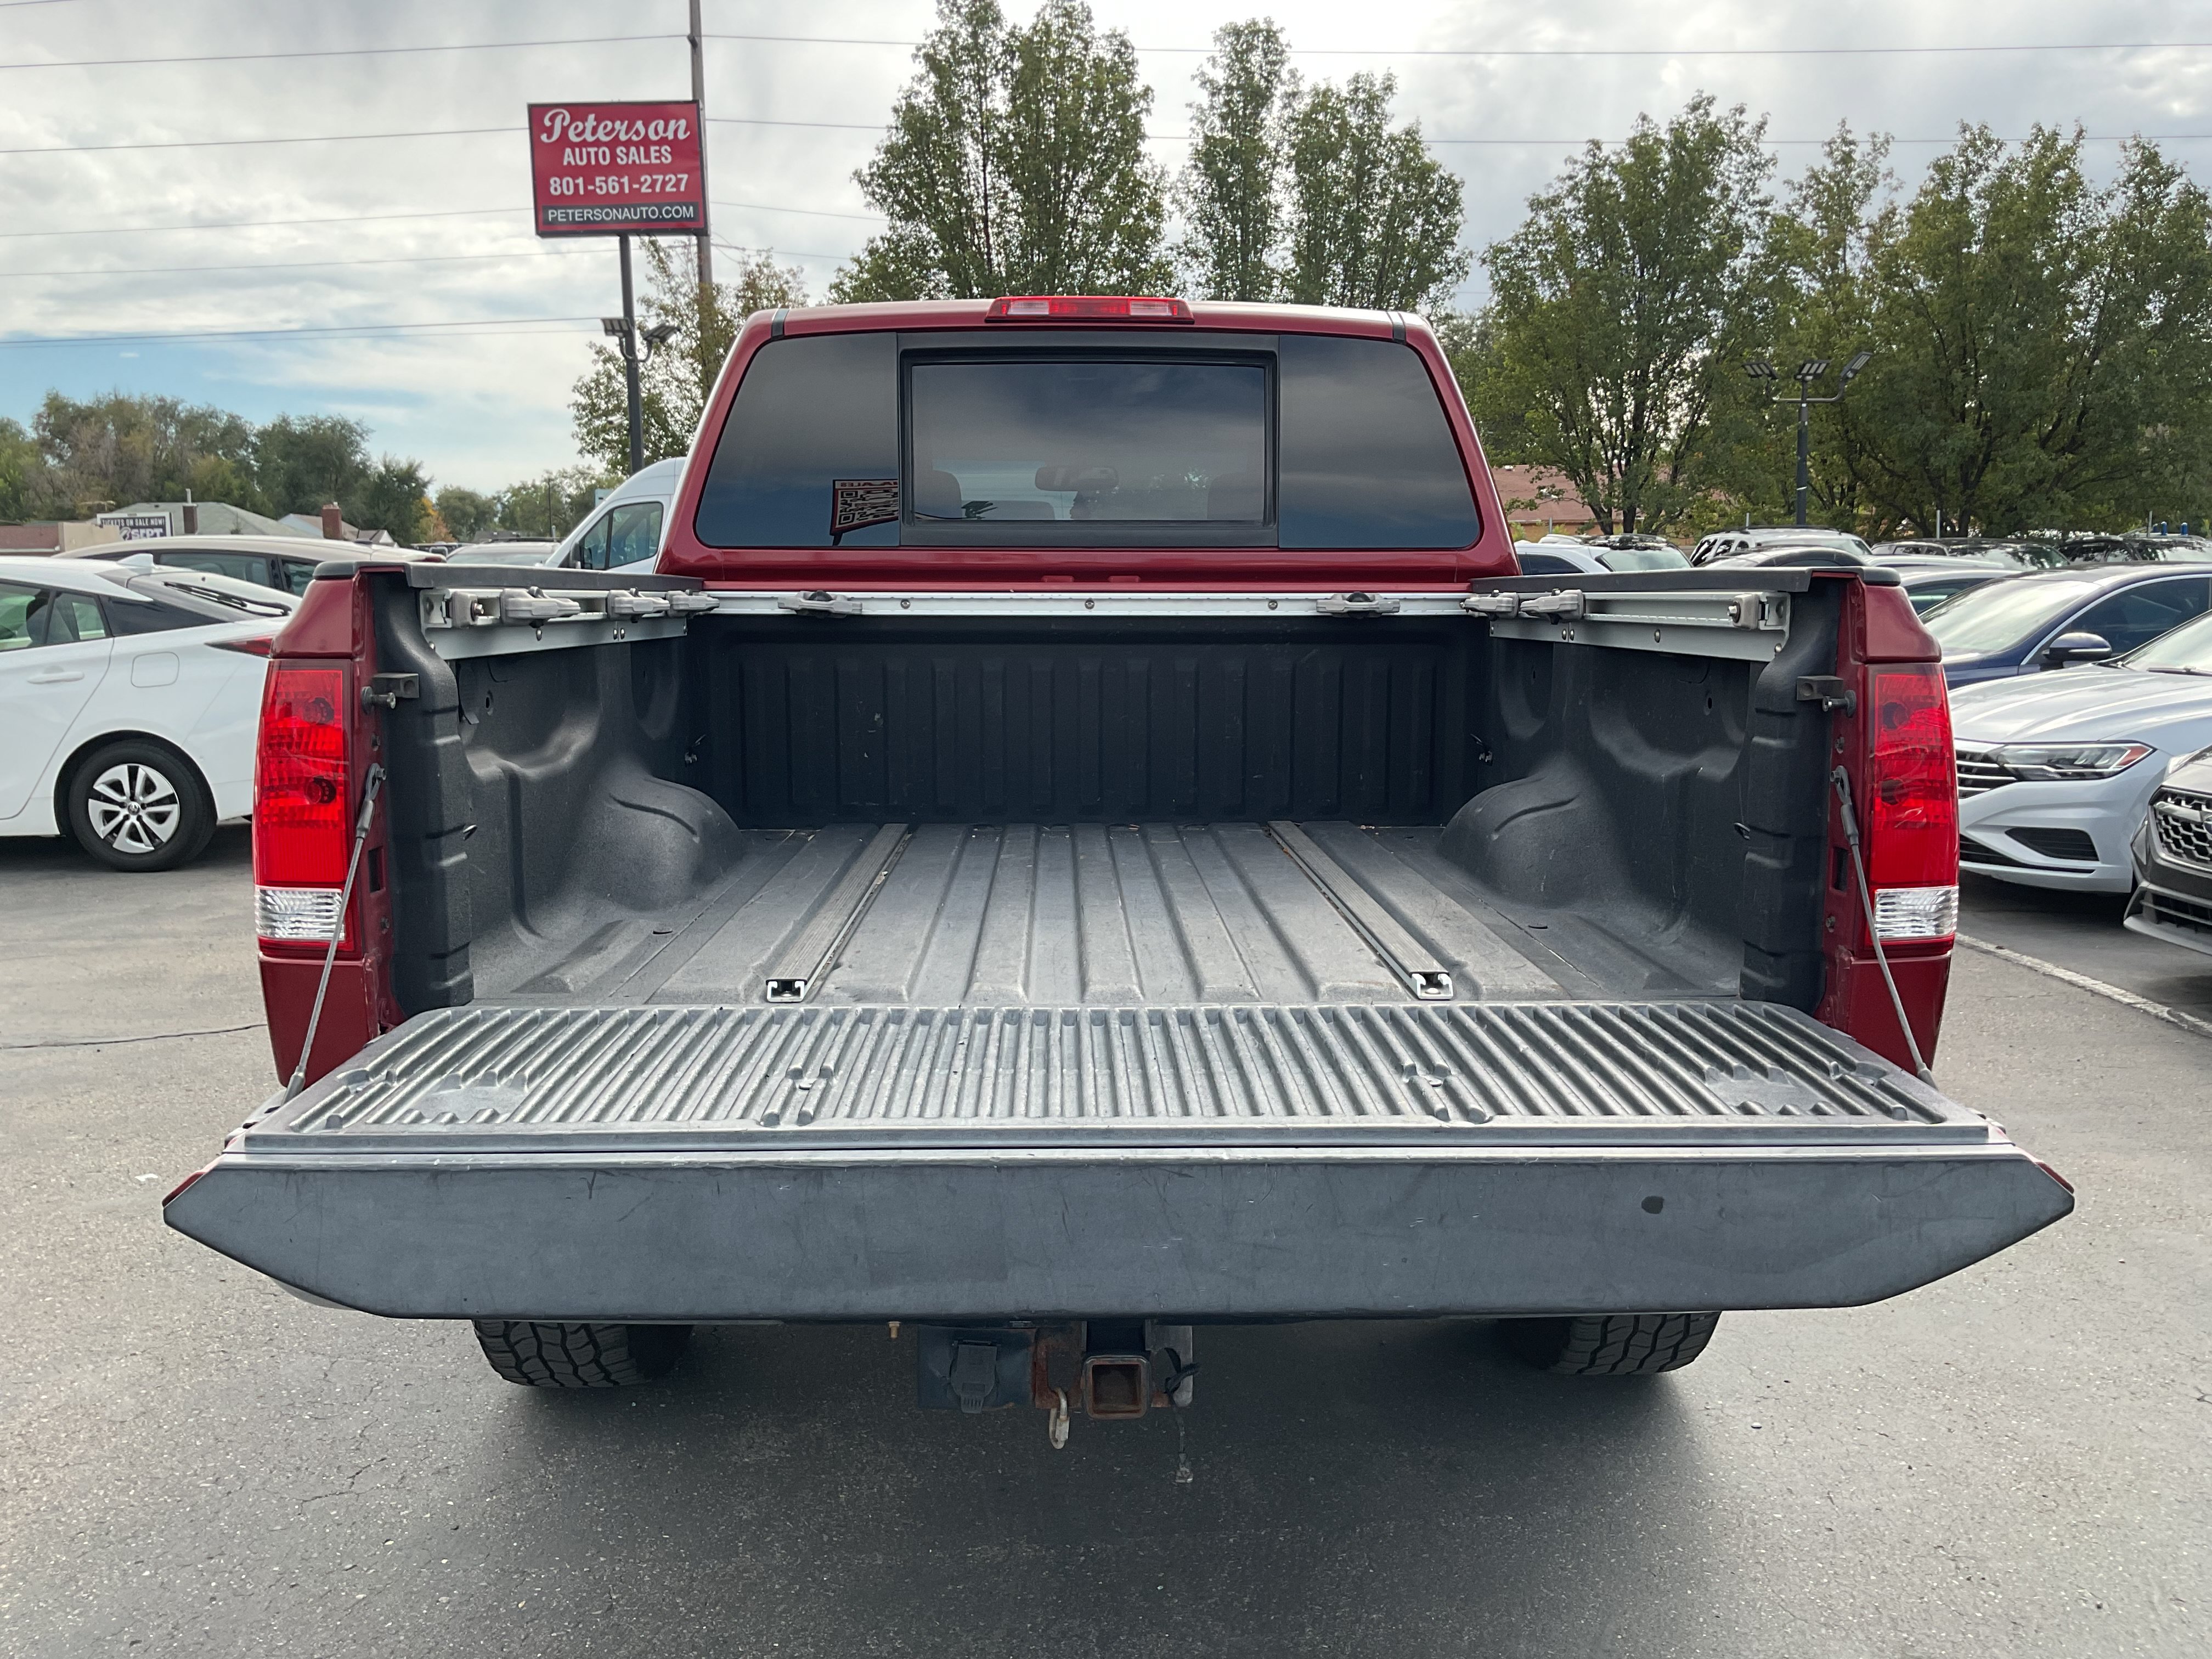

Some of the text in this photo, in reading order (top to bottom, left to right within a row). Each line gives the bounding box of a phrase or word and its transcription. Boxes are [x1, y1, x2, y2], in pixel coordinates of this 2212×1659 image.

[541, 109, 690, 143] Peterson
[563, 145, 672, 166] AUTO SALES
[550, 174, 688, 195] 801-561-2727
[549, 206, 694, 221] PETERSONAUTO.COM
[135, 518, 149, 526] SALE
